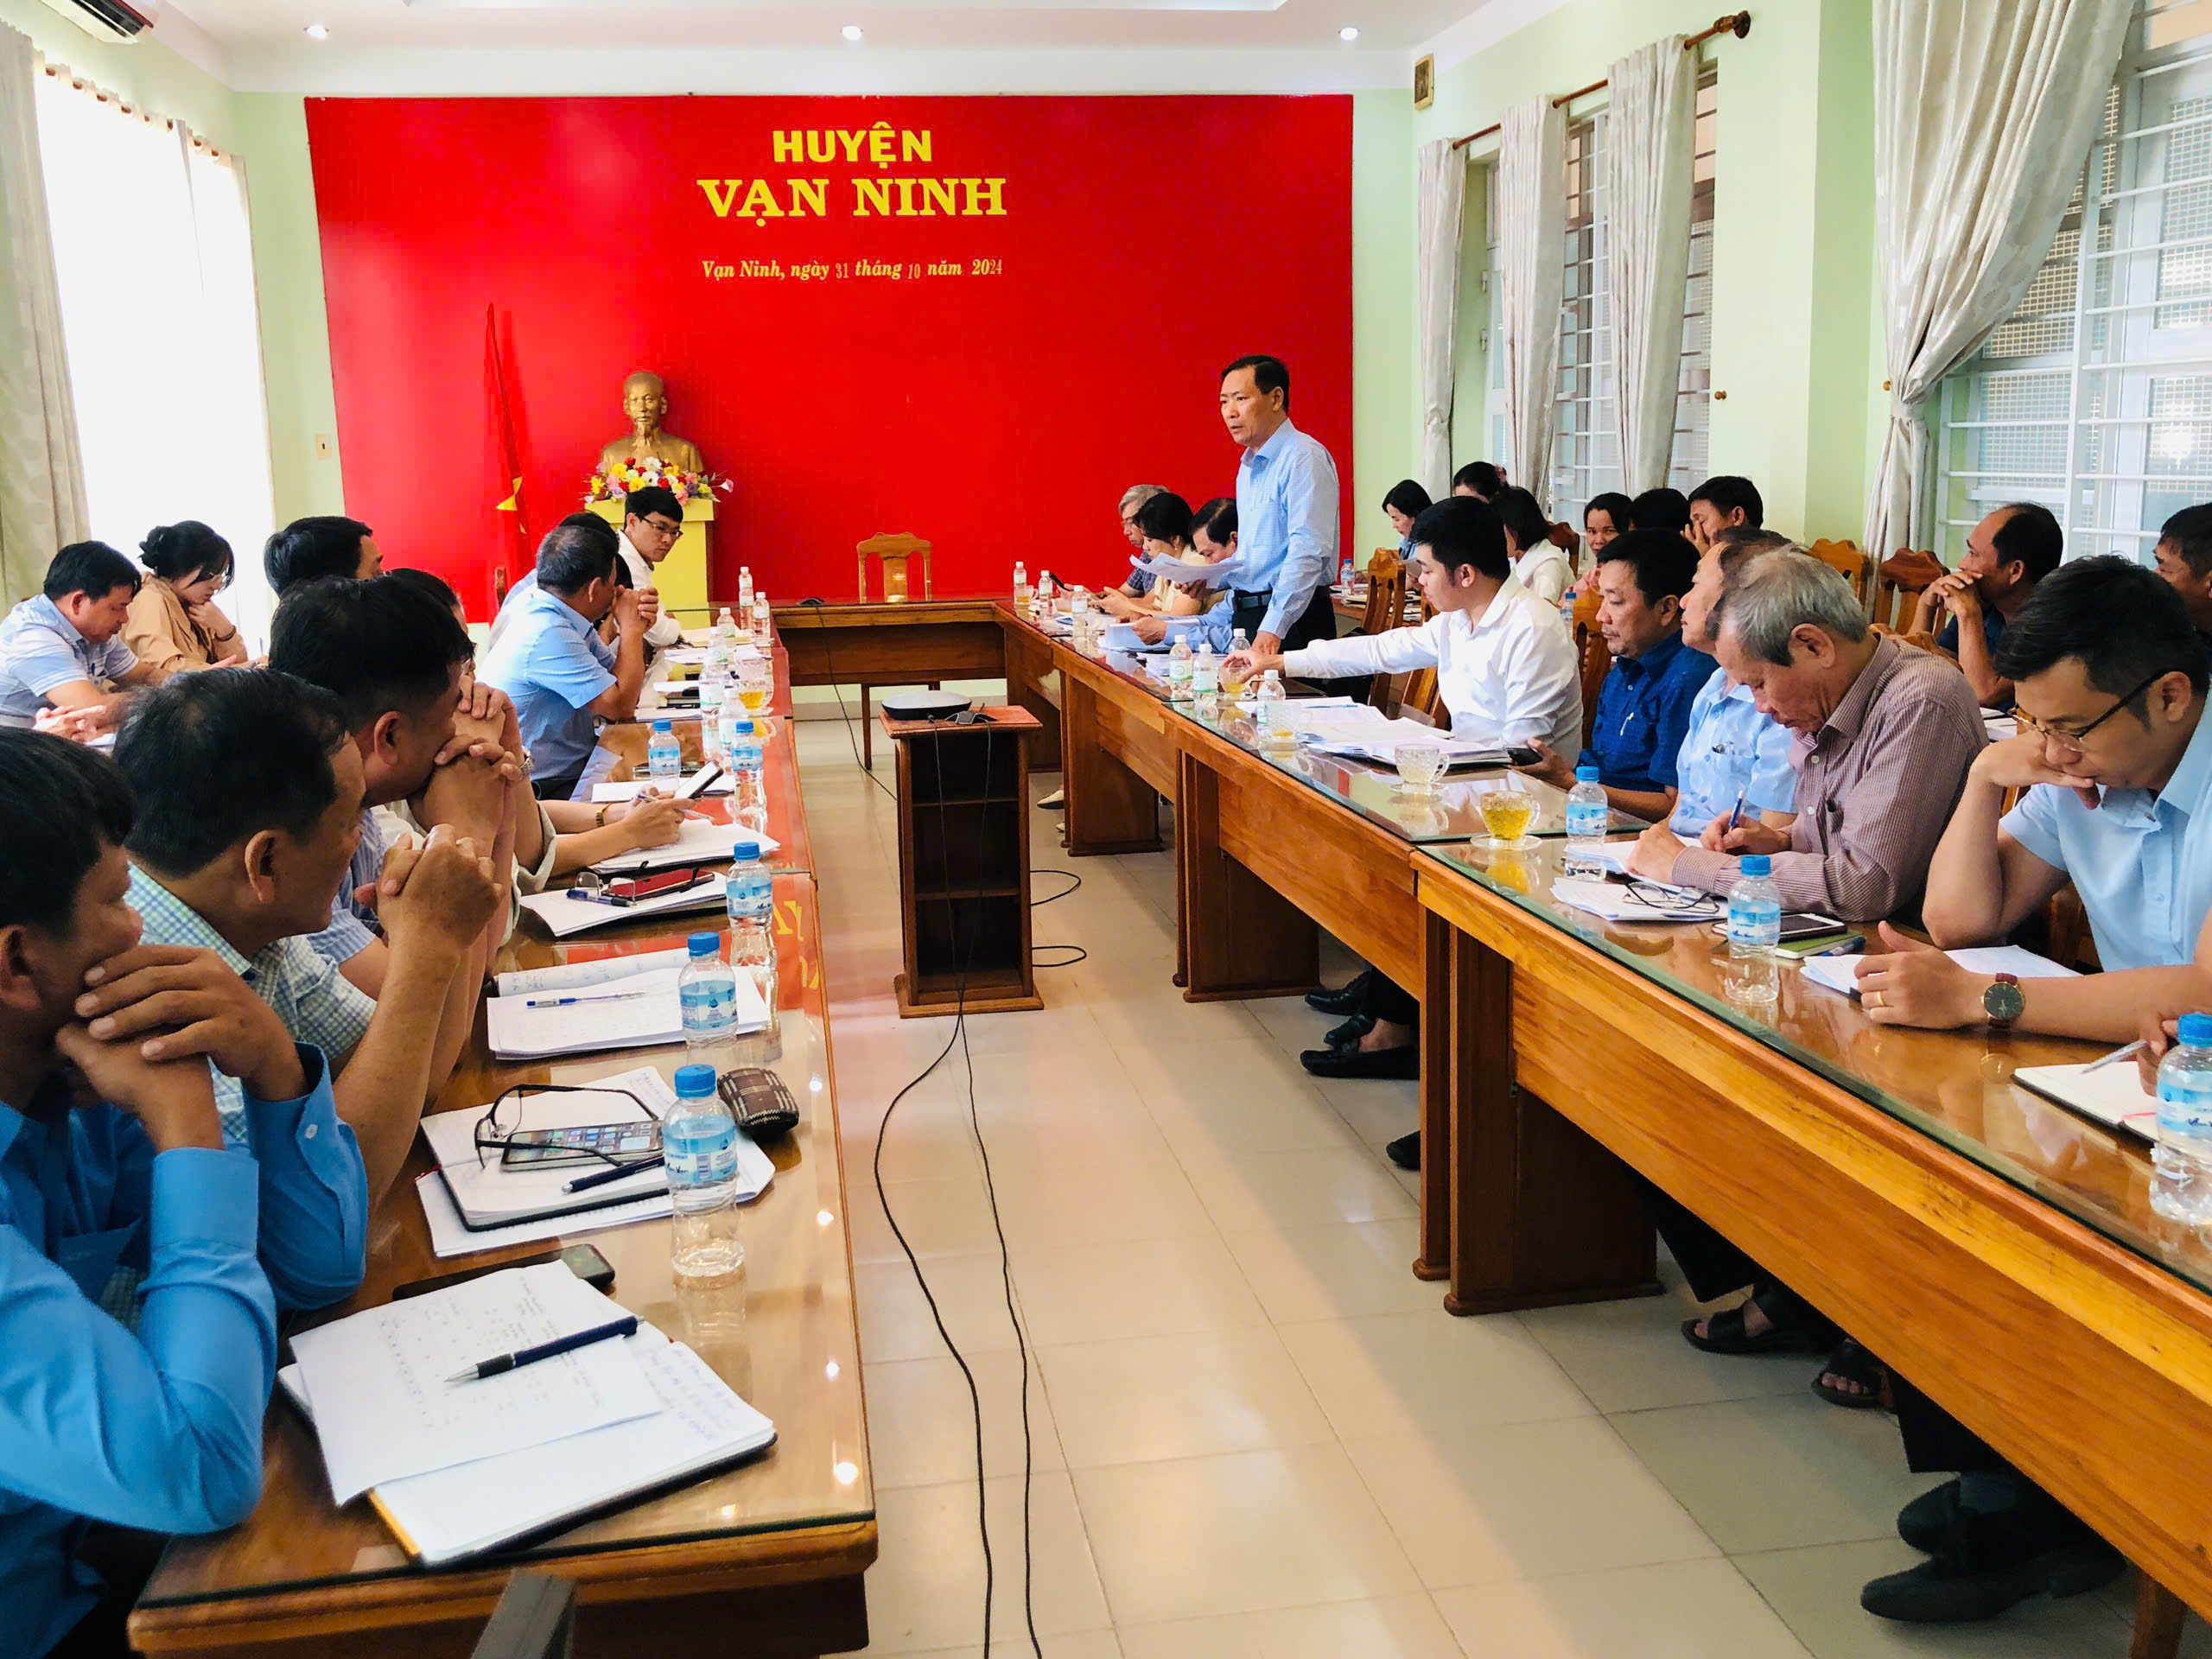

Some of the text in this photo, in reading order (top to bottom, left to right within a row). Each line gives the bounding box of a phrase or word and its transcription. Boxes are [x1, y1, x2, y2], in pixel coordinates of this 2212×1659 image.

[772, 121, 932, 169] HUYỆN
[696, 178, 1007, 227] VẠN NINH
[702, 258, 1002, 281] Vạn Ninh, ngày 31 tháng 10 năm 2024
